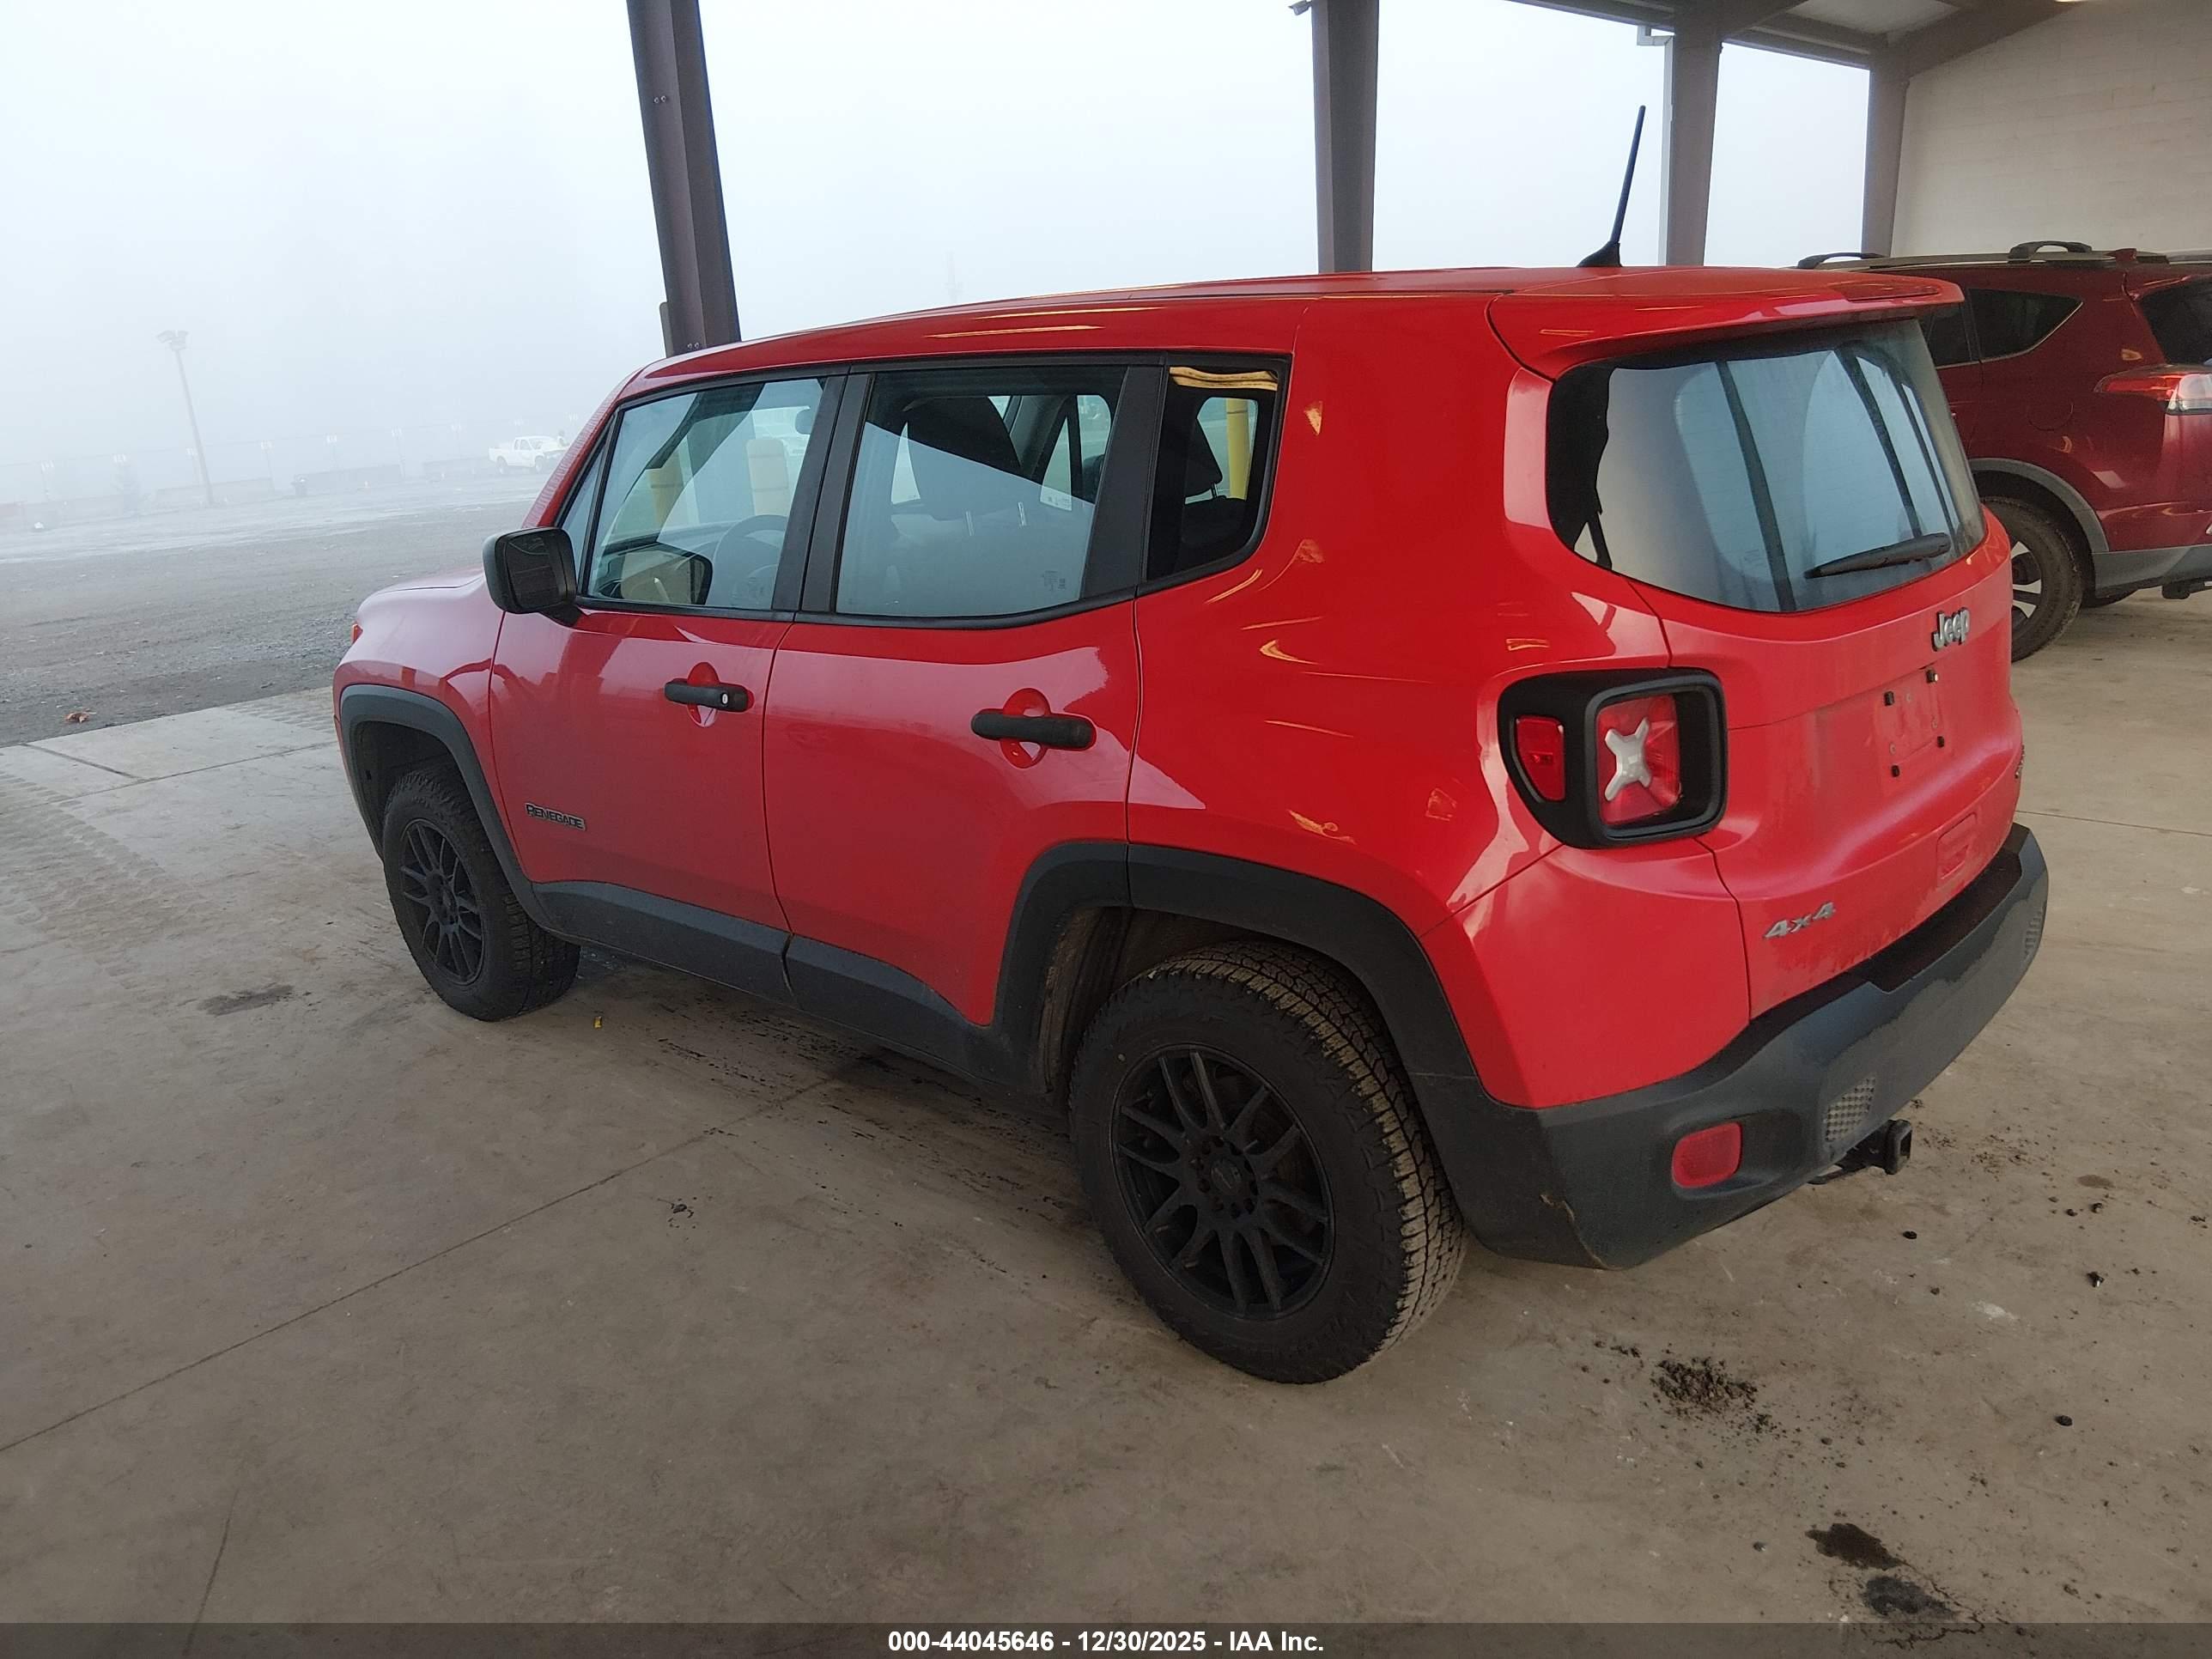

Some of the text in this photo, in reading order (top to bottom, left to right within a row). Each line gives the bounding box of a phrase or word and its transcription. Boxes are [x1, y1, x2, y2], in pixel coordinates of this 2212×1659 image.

[1932, 609, 1971, 649] Jeep
[525, 802, 586, 831] RENEGADE
[1764, 902, 1836, 939] 4x4
